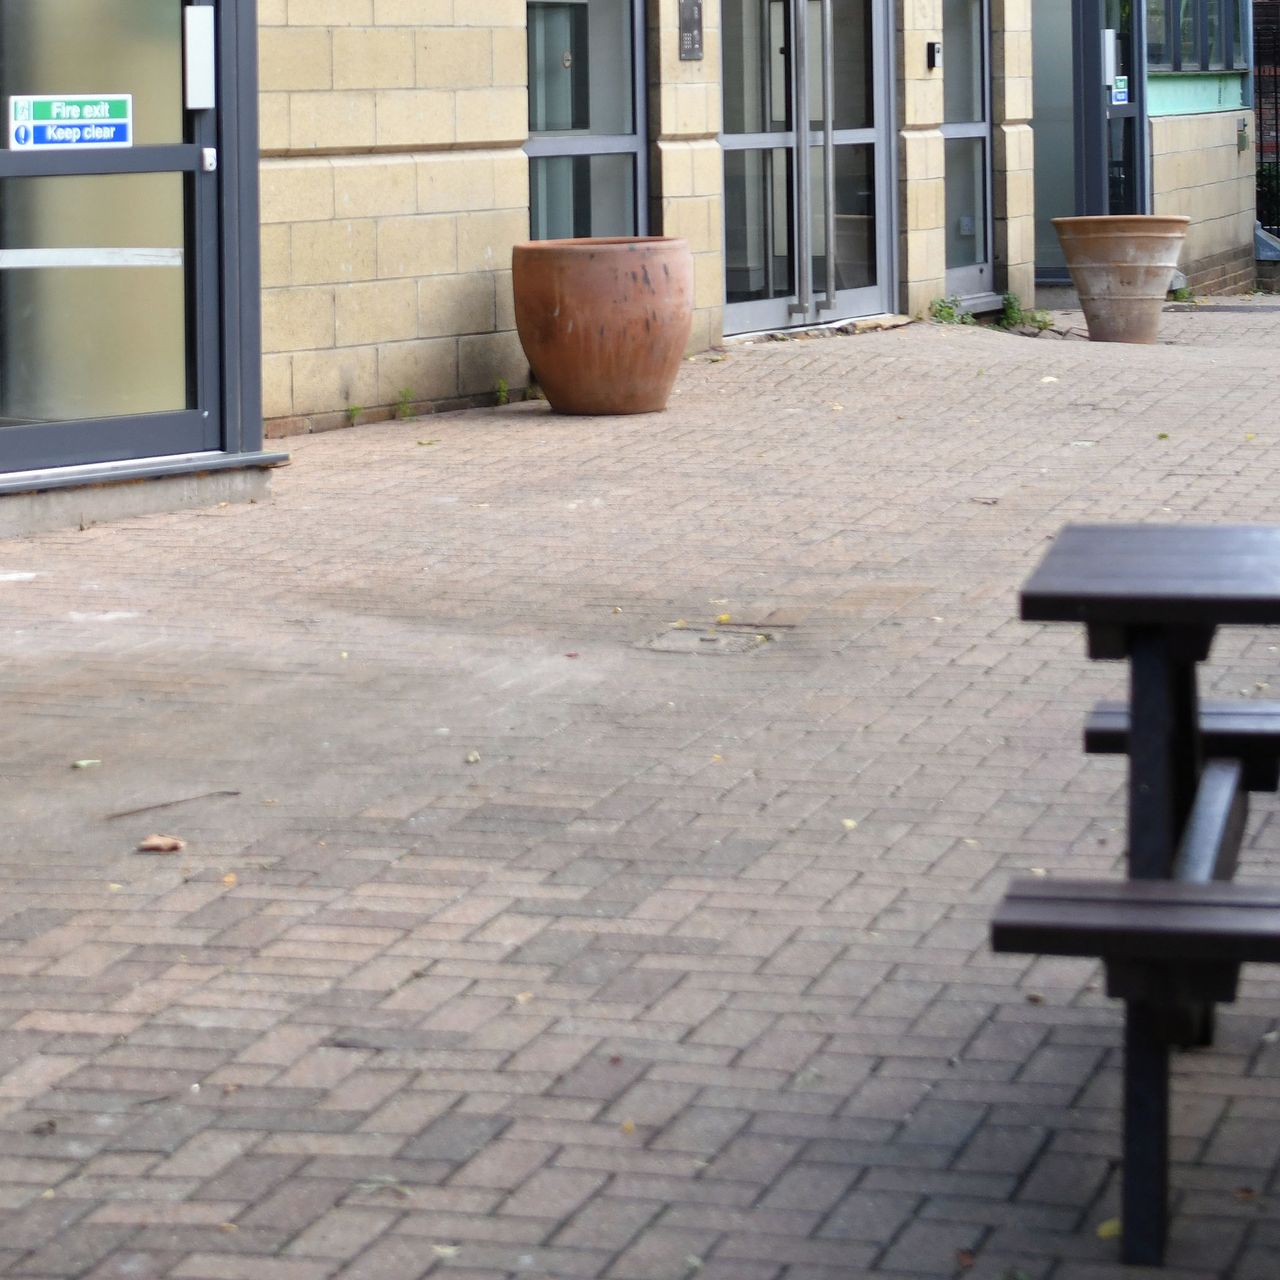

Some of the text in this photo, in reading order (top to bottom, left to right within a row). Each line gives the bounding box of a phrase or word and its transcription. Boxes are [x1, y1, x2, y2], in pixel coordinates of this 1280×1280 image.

[51, 101, 110, 119] Fire exit
[46, 124, 115, 142] Keep clear
